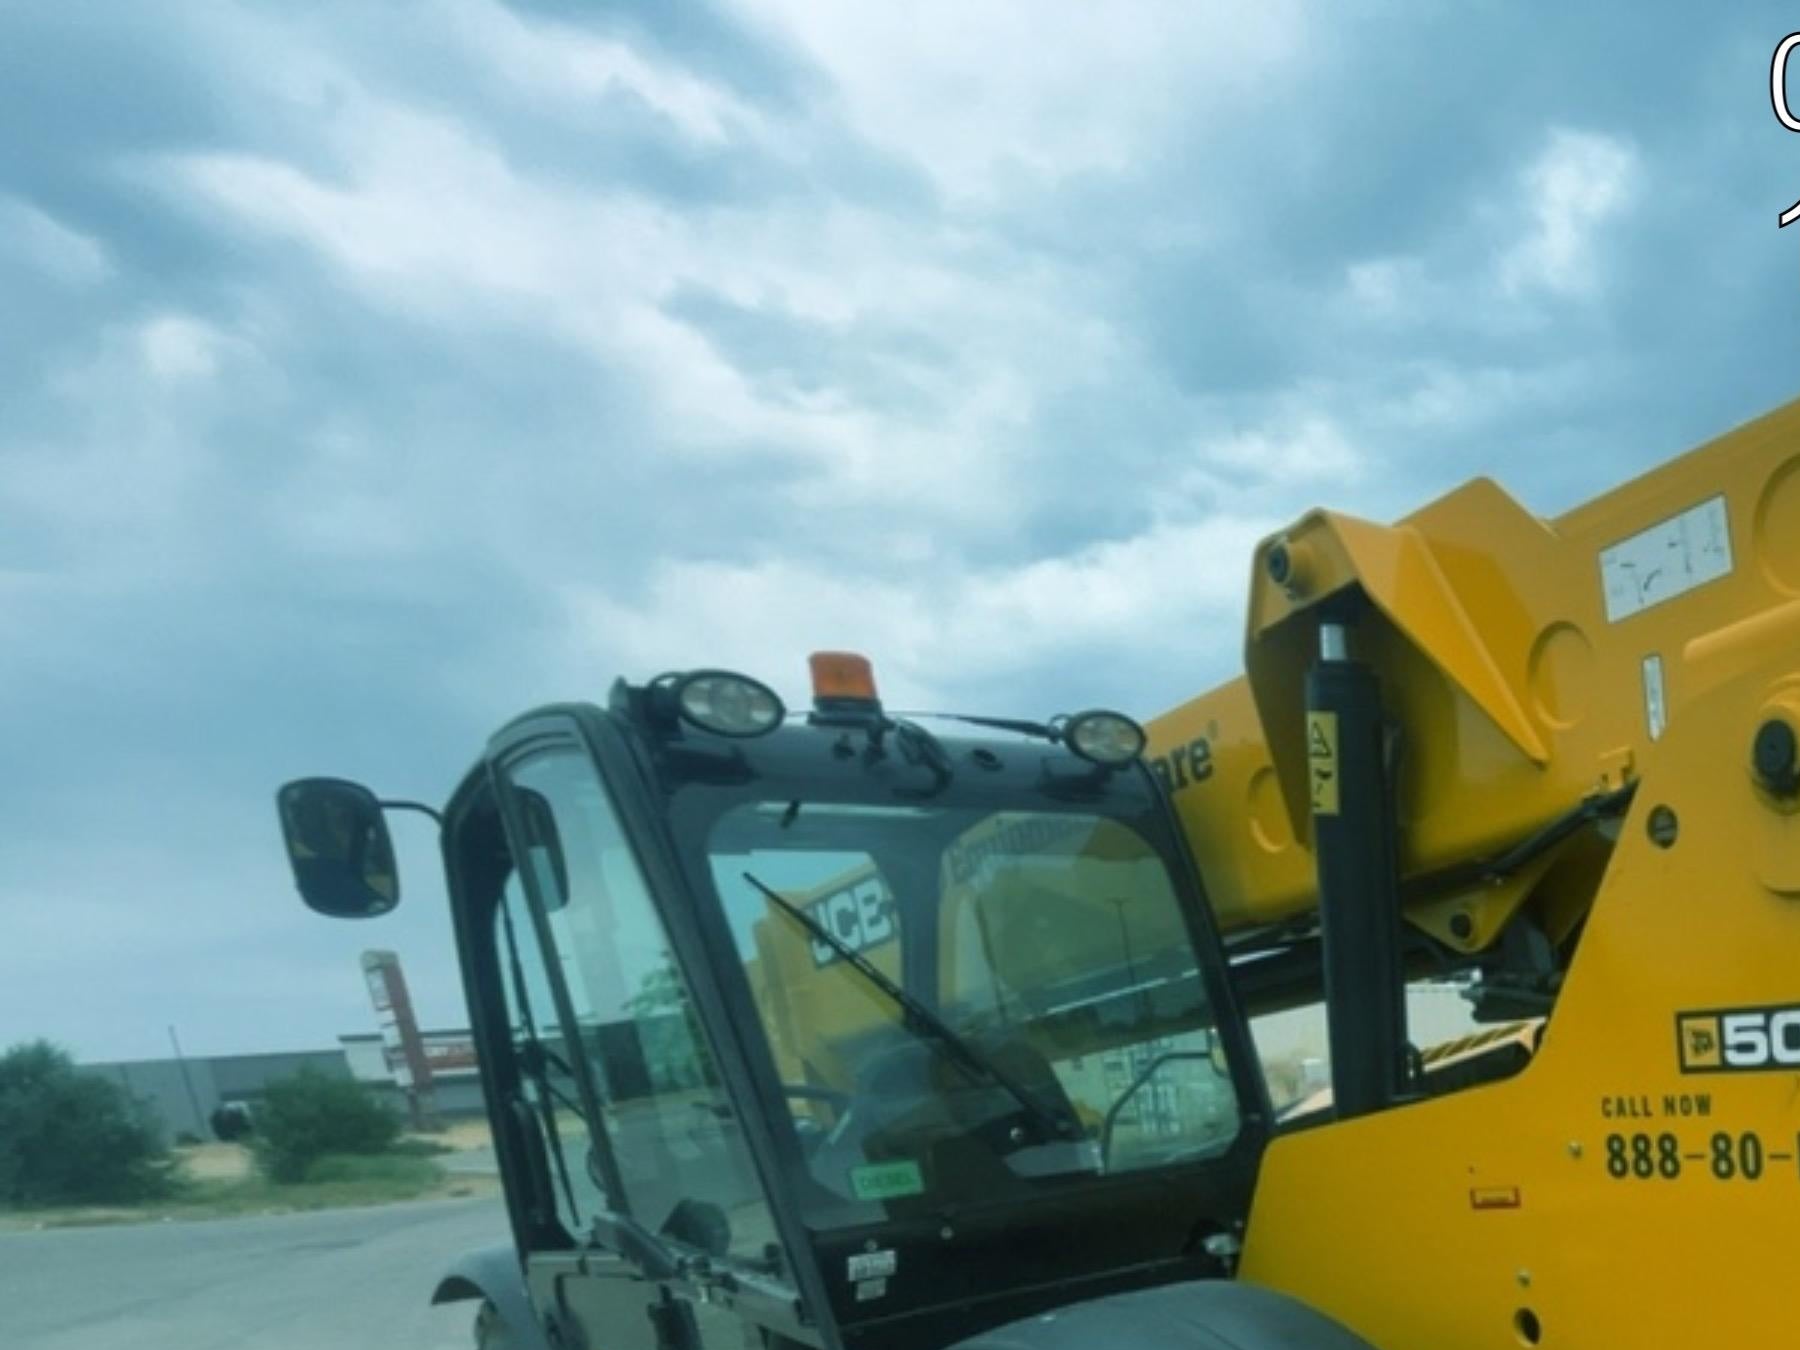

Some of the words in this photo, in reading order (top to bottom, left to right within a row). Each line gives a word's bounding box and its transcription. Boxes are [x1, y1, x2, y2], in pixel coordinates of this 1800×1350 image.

[812, 876, 893, 964] JCB
[1601, 1097, 1654, 1118] CALL
[1664, 1094, 1712, 1117] NOW
